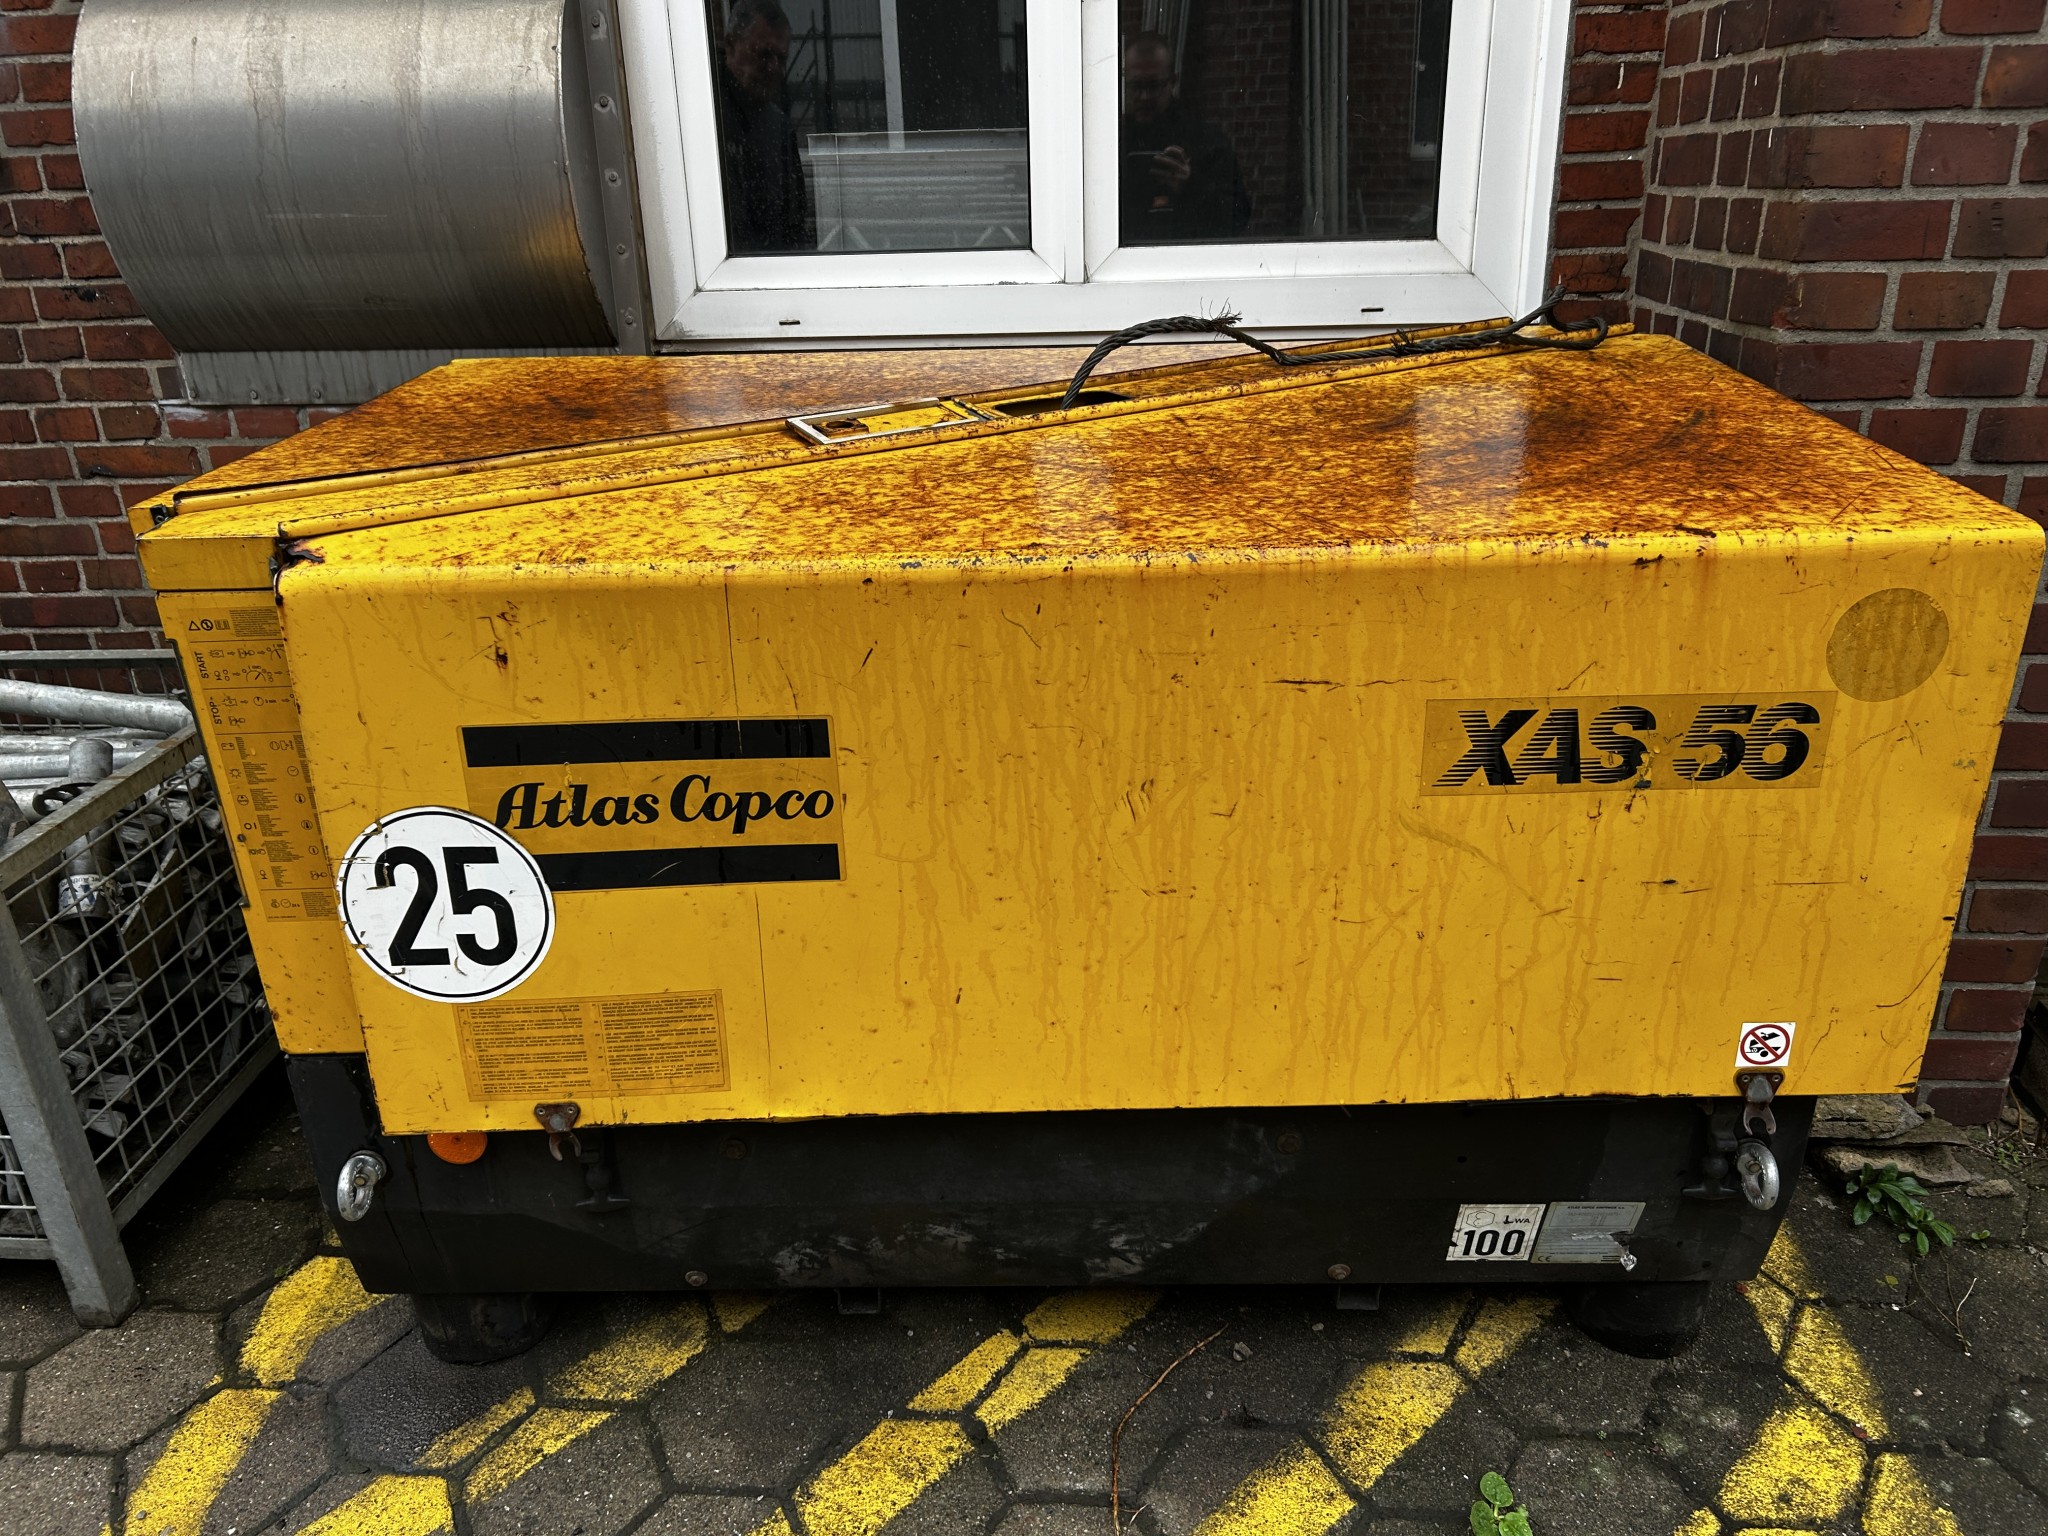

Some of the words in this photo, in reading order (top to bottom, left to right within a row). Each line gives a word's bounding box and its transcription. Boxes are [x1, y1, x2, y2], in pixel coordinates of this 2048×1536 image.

[194, 651, 210, 679] START
[1431, 705, 1658, 788] XAS
[1672, 701, 1821, 783] 56
[494, 782, 660, 830] Atlas
[670, 774, 835, 835] Copco
[374, 845, 519, 967] 25
[1461, 1229, 1526, 1256] 100
